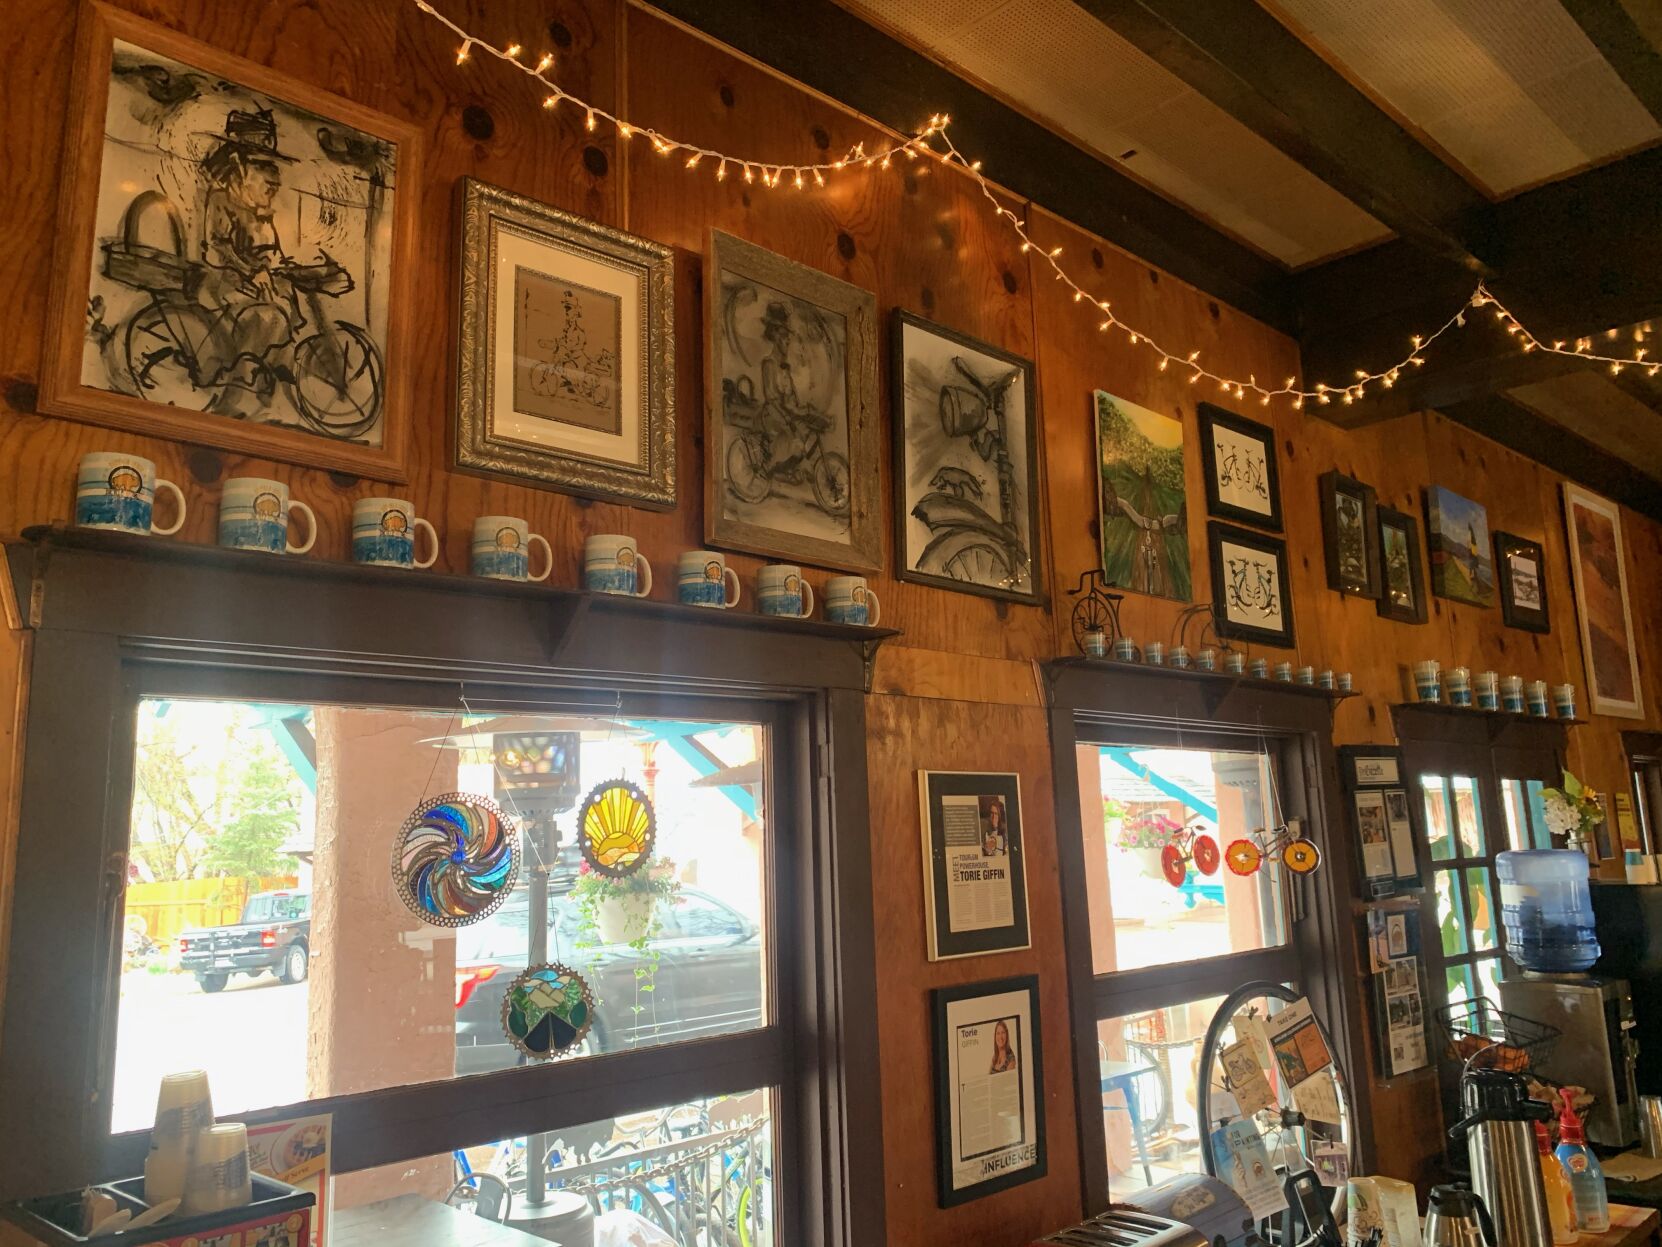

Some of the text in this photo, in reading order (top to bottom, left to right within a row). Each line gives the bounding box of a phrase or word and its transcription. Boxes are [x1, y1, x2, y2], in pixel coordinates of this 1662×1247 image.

[960, 869, 1004, 881] TORIE GIFFIN
[961, 1028, 978, 1038] Torie
[984, 1151, 1036, 1174] INFLUENCE
